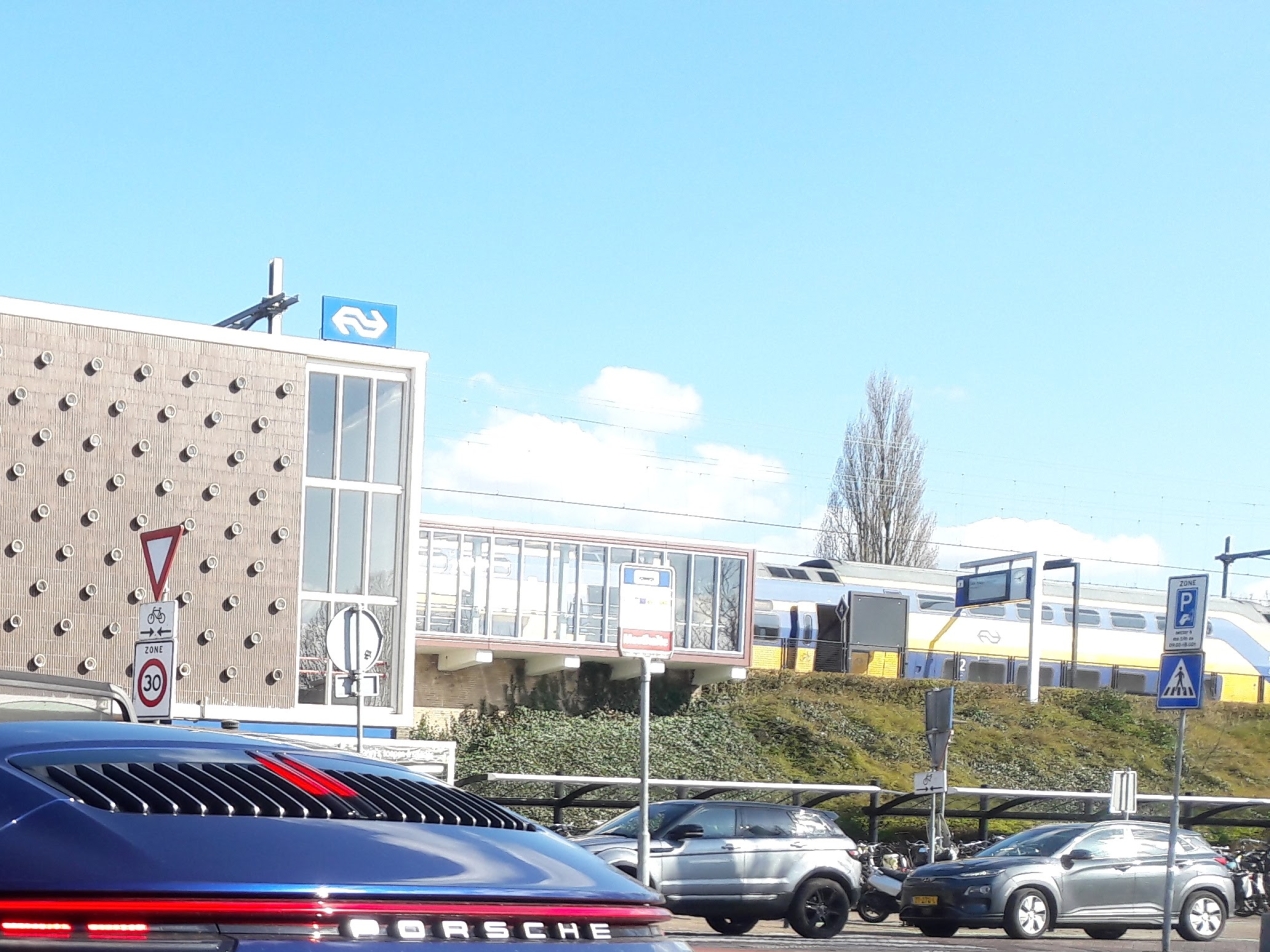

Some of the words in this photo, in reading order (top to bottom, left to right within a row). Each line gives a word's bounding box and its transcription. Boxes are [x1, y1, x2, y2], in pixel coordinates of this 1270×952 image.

[1180, 592, 1193, 612] P
[145, 646, 163, 654] ZONE
[143, 675, 161, 691] 30
[349, 919, 612, 939] PORSCHE
